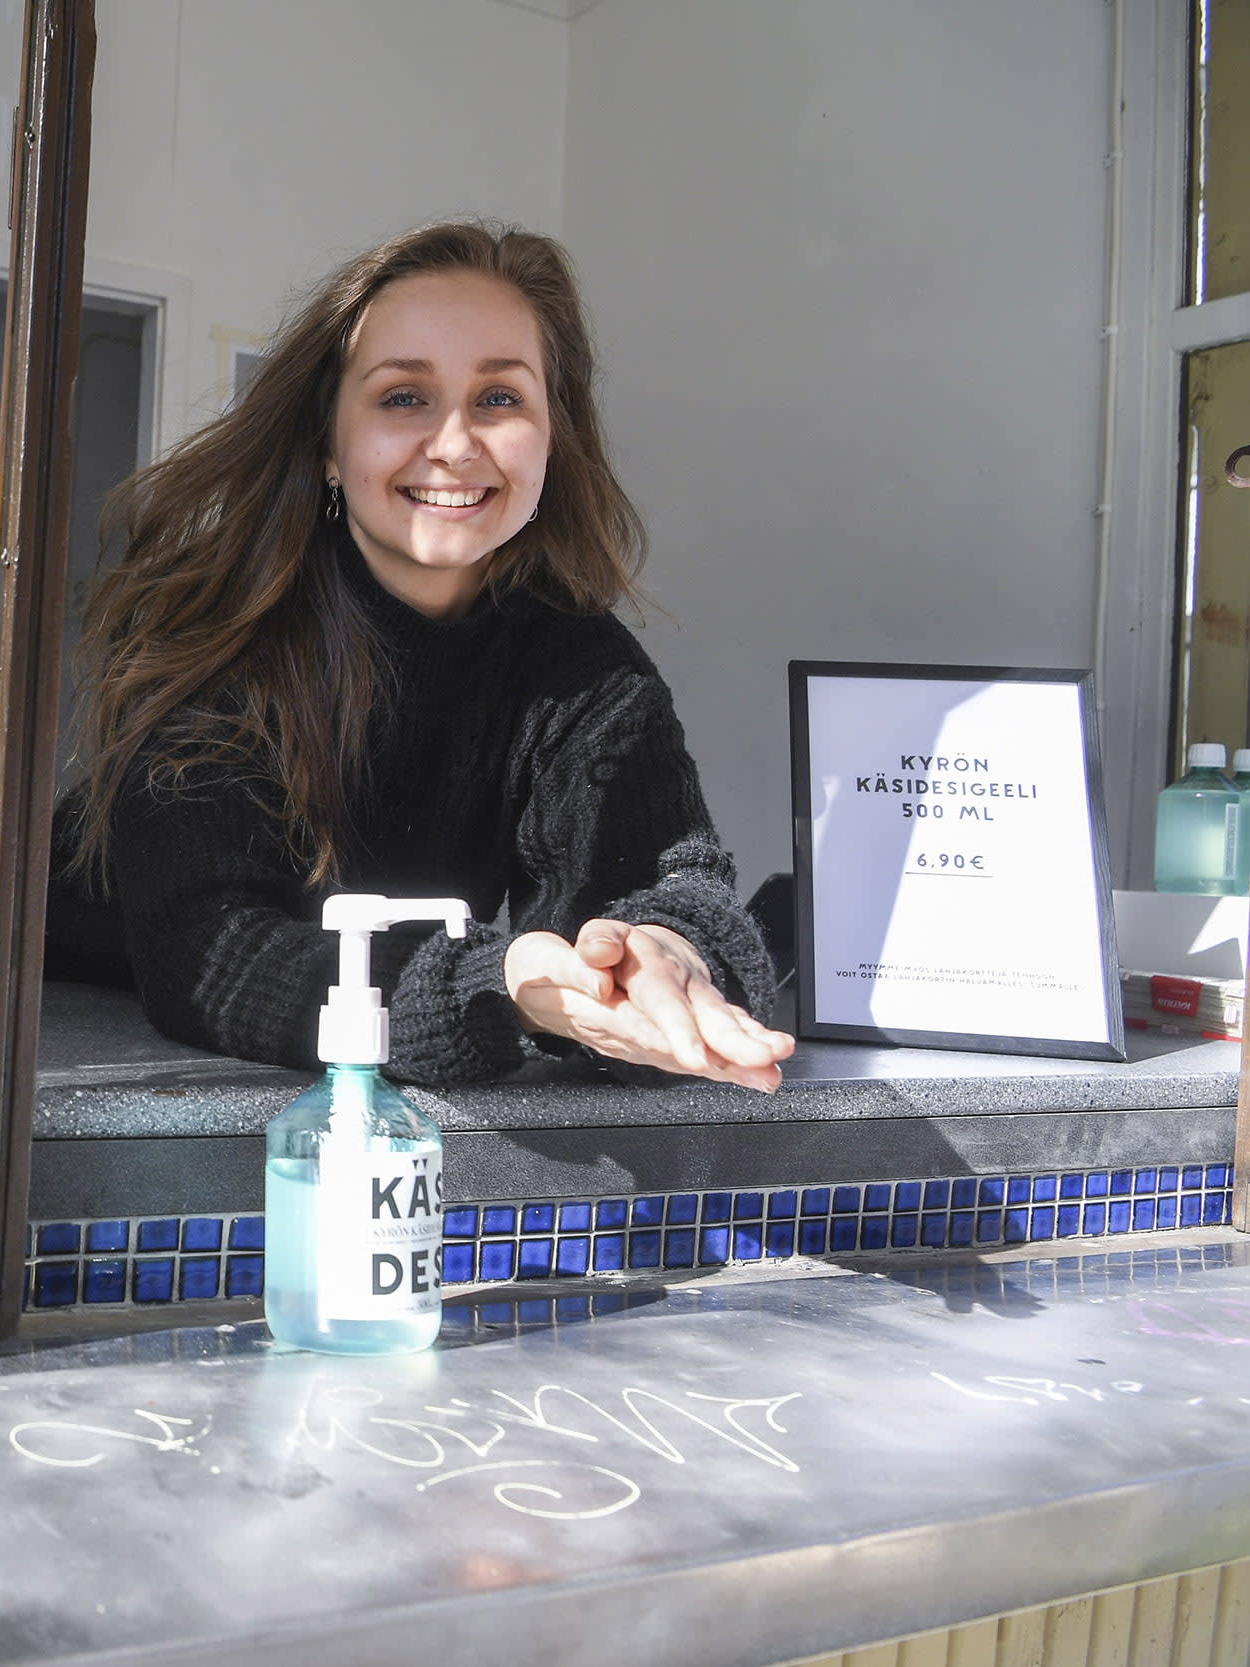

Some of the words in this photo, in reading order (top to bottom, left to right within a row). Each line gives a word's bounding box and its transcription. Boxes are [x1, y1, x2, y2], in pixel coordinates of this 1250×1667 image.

[901, 752, 990, 773] KYRÖN
[855, 772, 1038, 799] KÄSIDESIGEELI
[901, 802, 945, 819] 500
[959, 806, 996, 821] ML
[917, 852, 986, 870] 6,90€
[836, 970, 857, 978] VOIT
